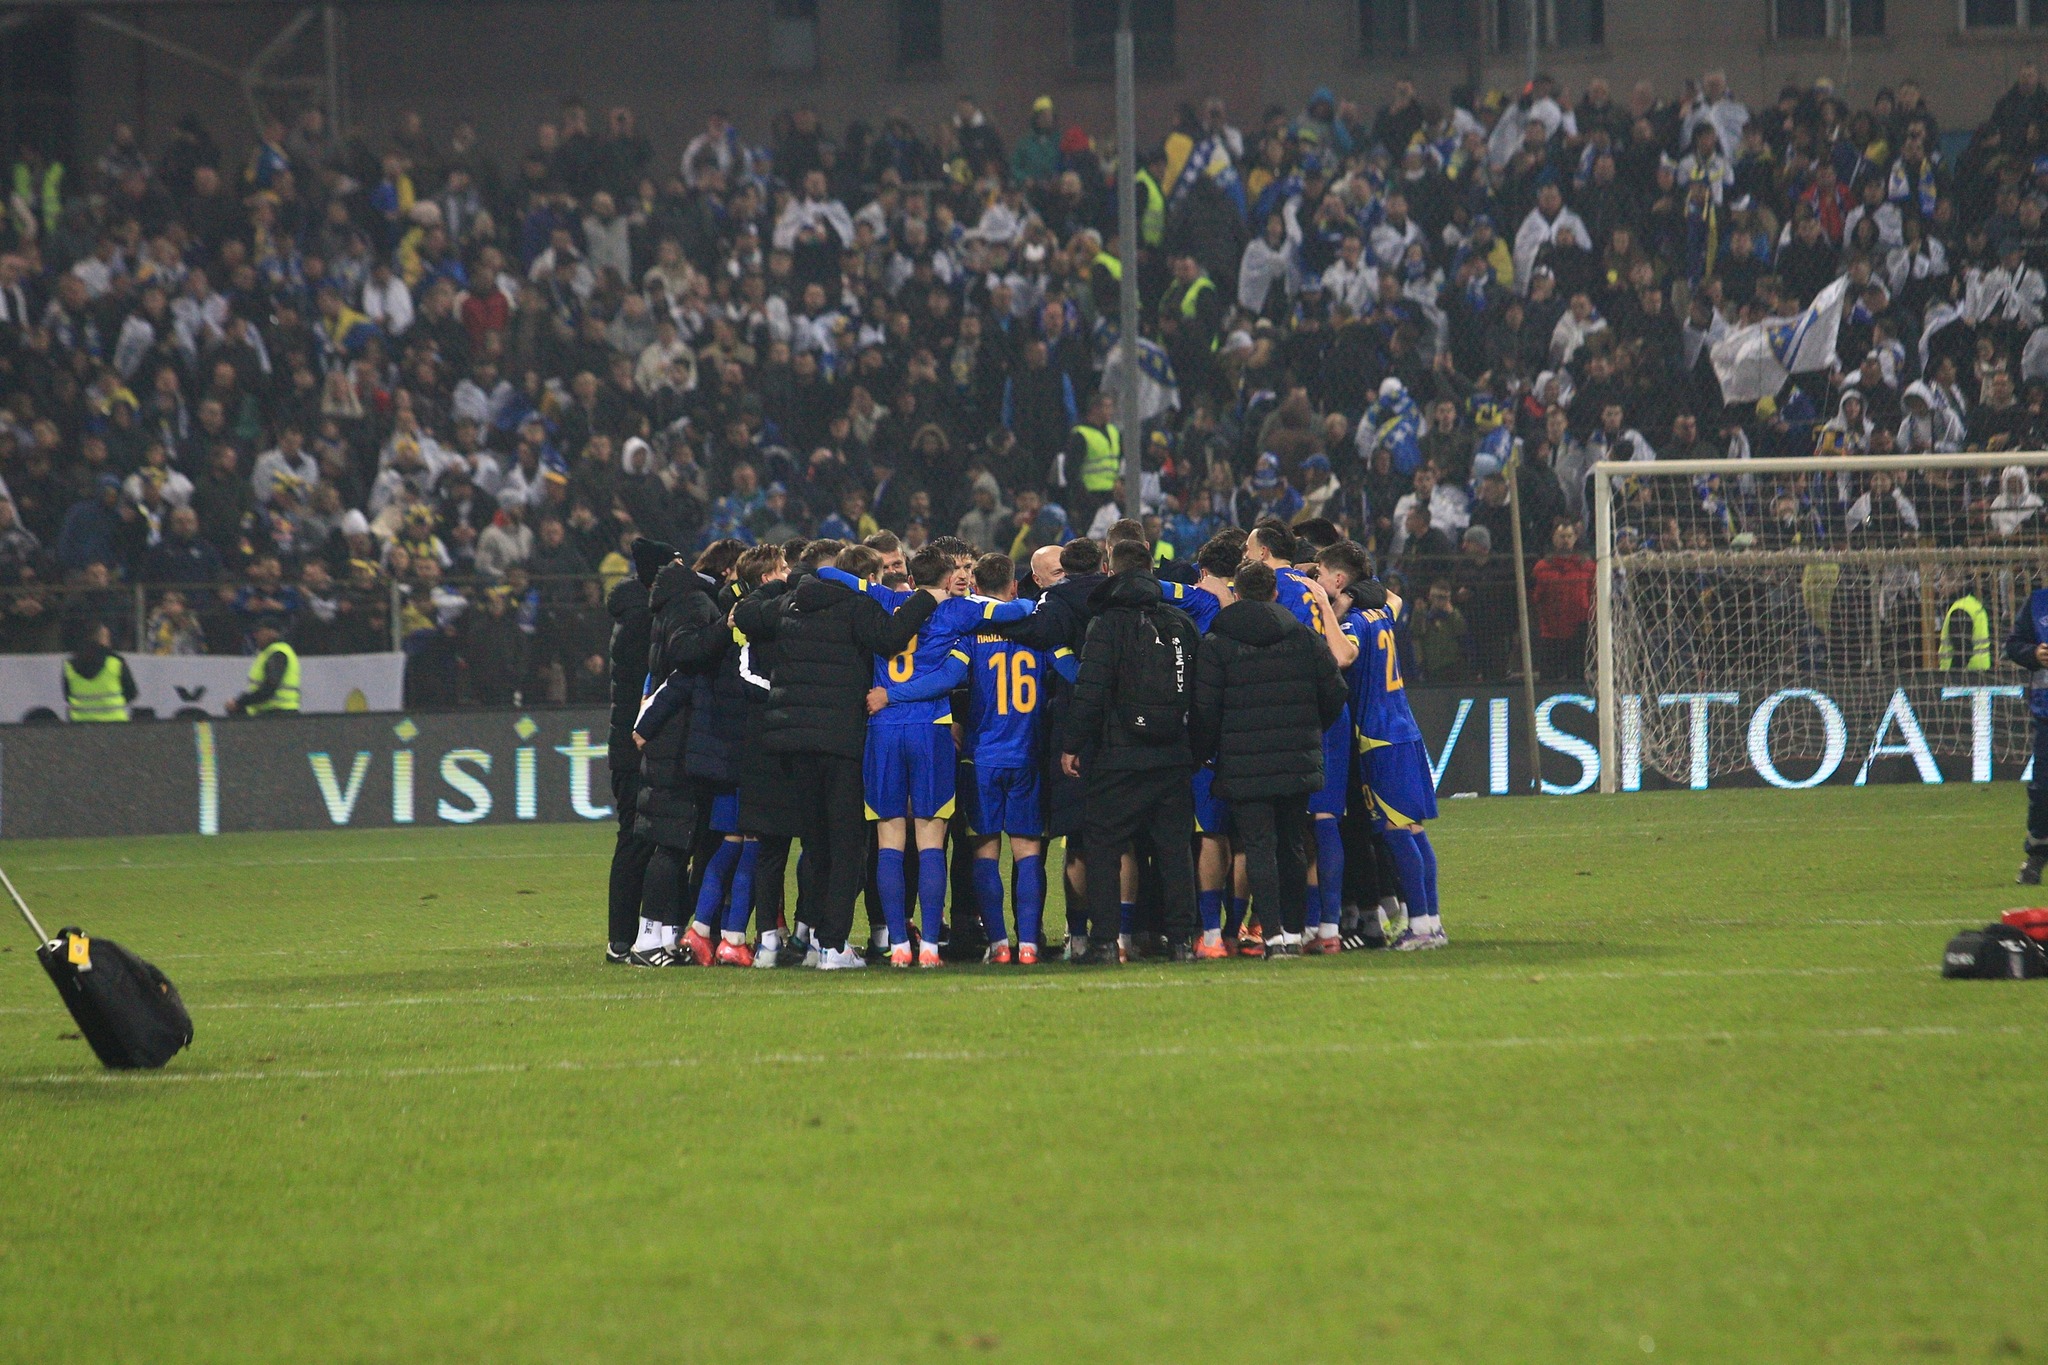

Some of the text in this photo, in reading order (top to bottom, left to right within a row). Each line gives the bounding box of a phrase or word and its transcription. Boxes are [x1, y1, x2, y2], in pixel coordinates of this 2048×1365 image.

[988, 650, 1037, 715] 16
[1175, 645, 1185, 693] KELME
[307, 716, 613, 825] visit
